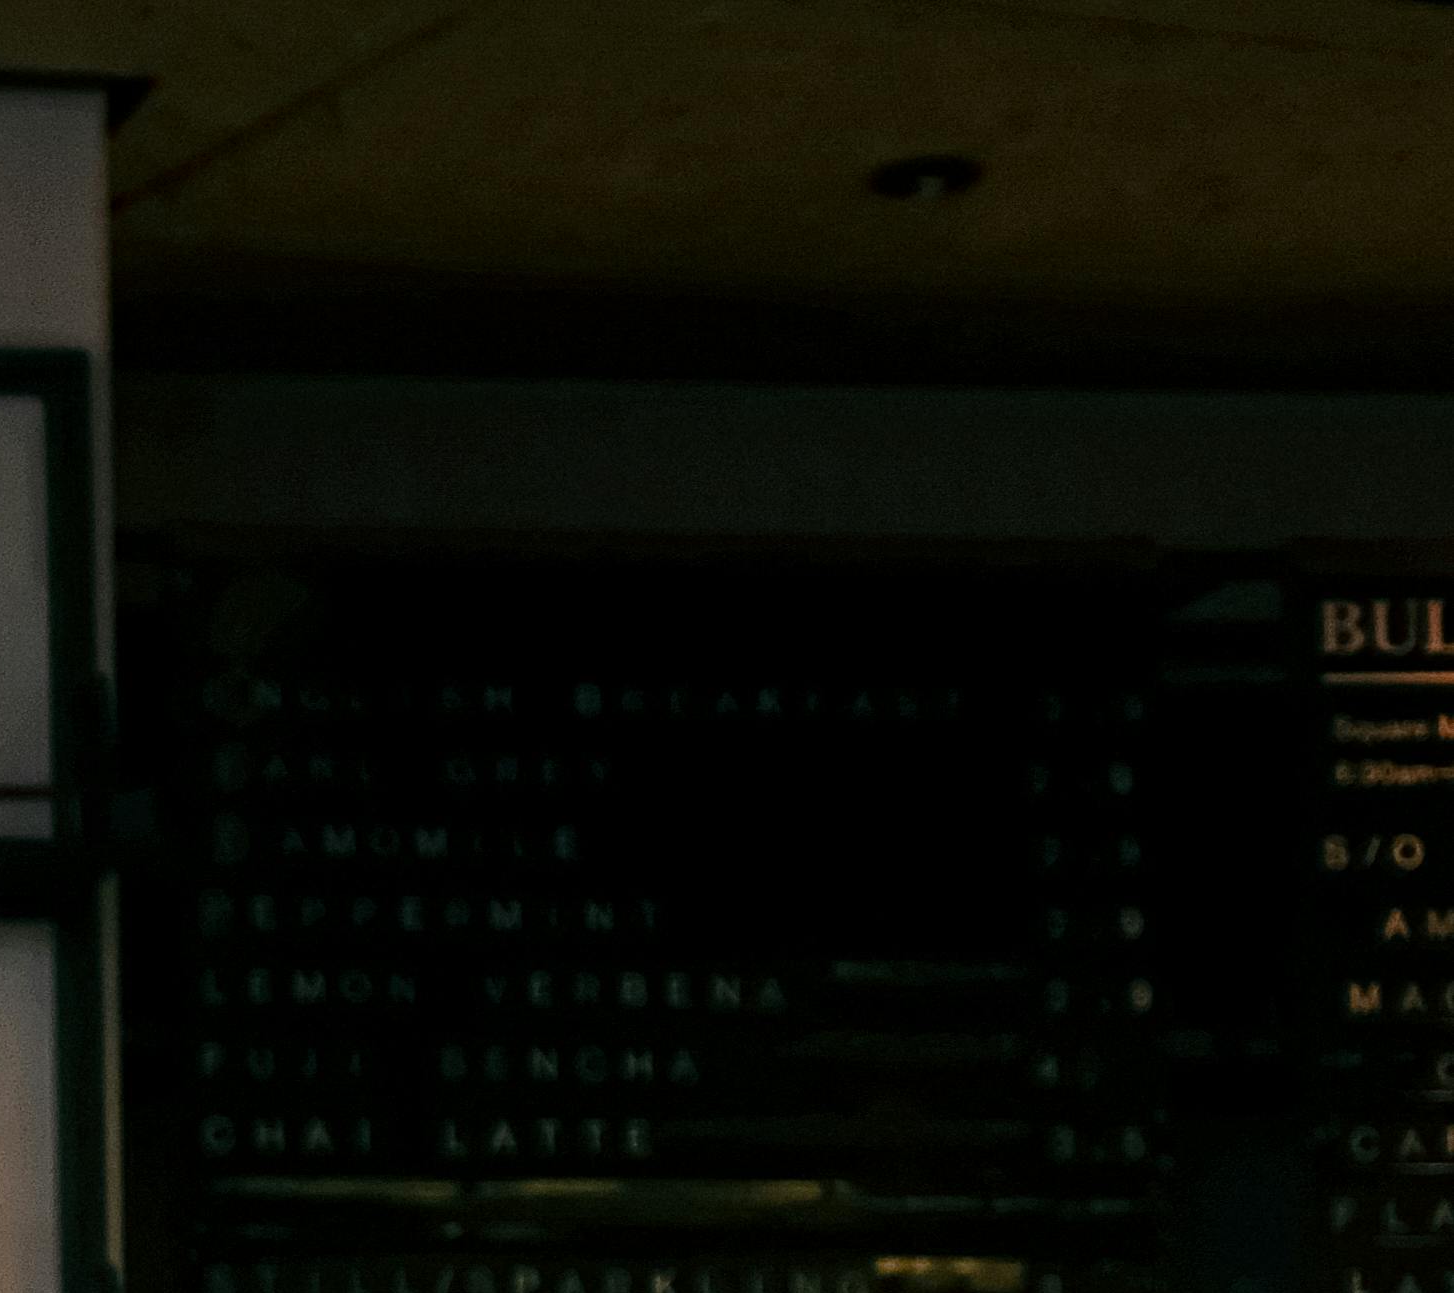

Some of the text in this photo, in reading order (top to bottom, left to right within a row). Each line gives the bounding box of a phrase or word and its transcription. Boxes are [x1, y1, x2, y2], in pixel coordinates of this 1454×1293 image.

[201, 967, 417, 1005] LEMON
[201, 1114, 372, 1157] CHAI
[444, 1116, 651, 1158] LATTE
